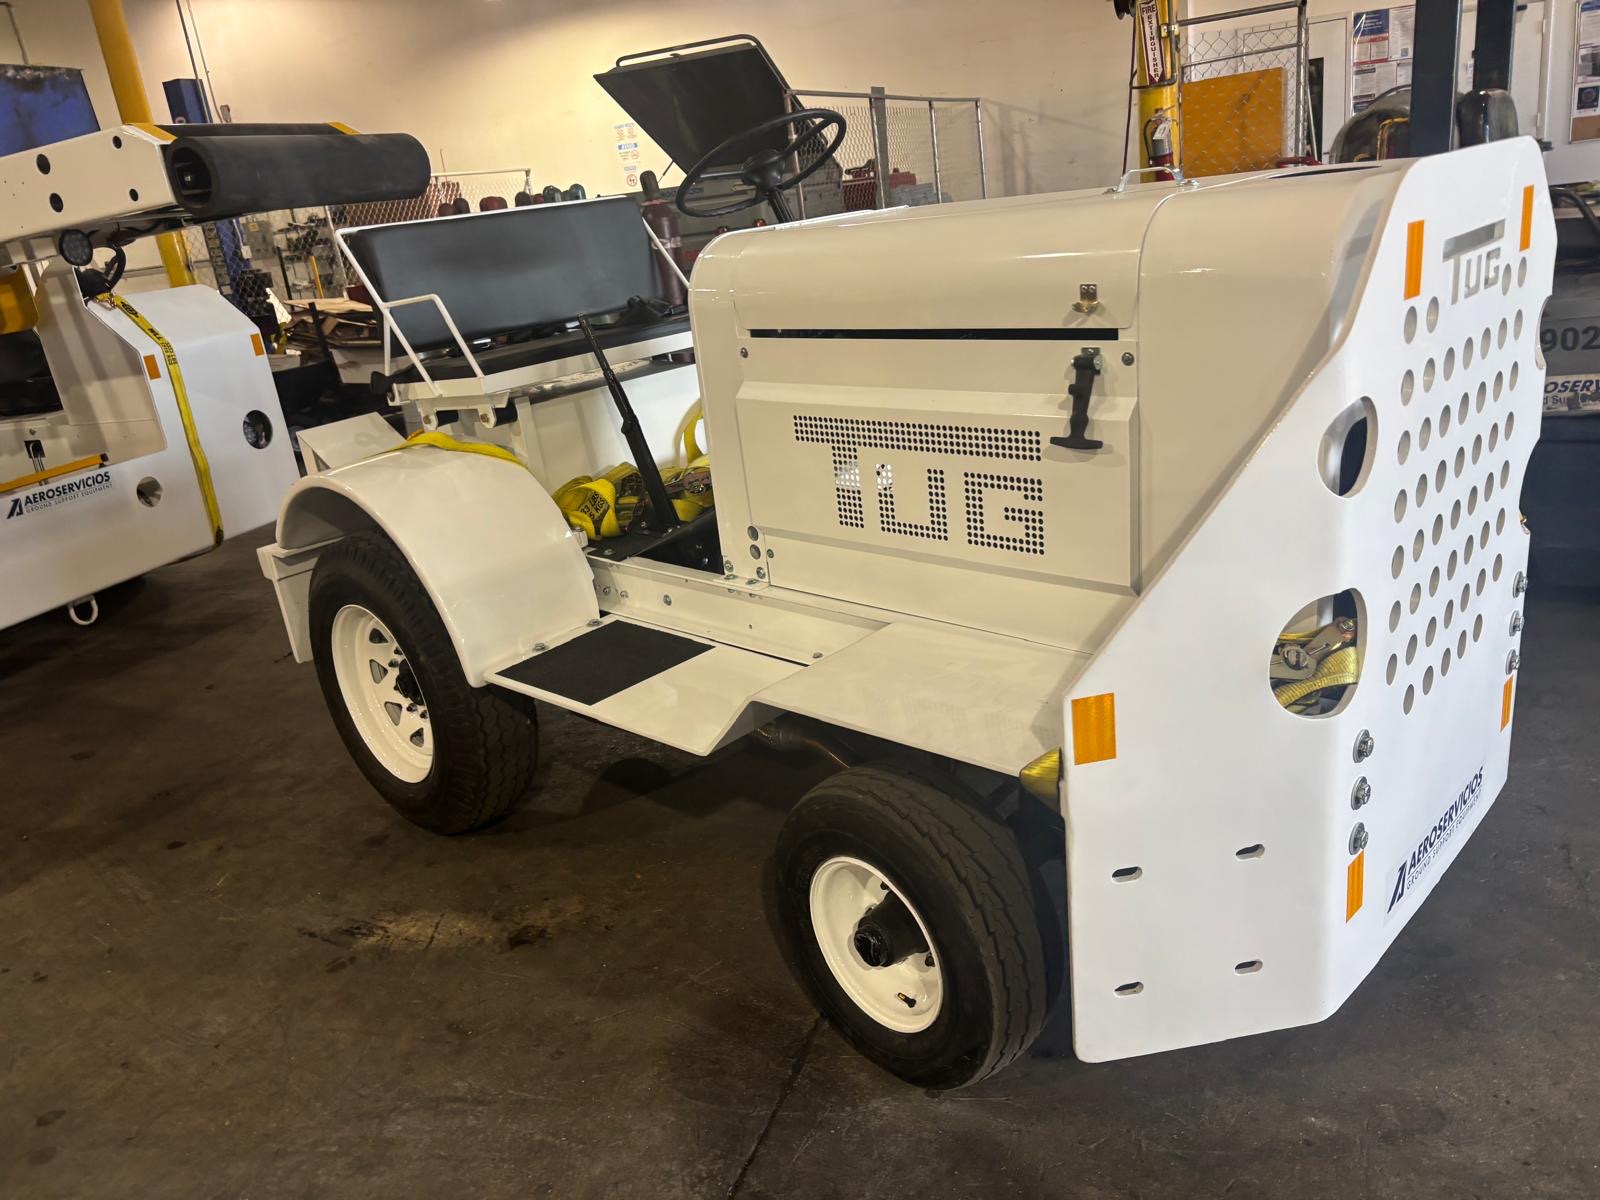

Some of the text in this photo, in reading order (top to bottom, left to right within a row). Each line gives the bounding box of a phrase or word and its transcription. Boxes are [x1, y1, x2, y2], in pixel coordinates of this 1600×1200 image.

[1142, 5, 1156, 16] FIRE
[1147, 15, 1160, 78] EXTINGUISHER
[1442, 217, 1506, 306] TUG
[24, 471, 111, 506] AEROSERVICIOS
[26, 502, 53, 514] GROUND
[55, 494, 80, 505] SUPPORT
[793, 414, 1045, 556] TUG
[1407, 766, 1484, 876] AEROSERVICIOS
[1406, 855, 1432, 890] GROUND
